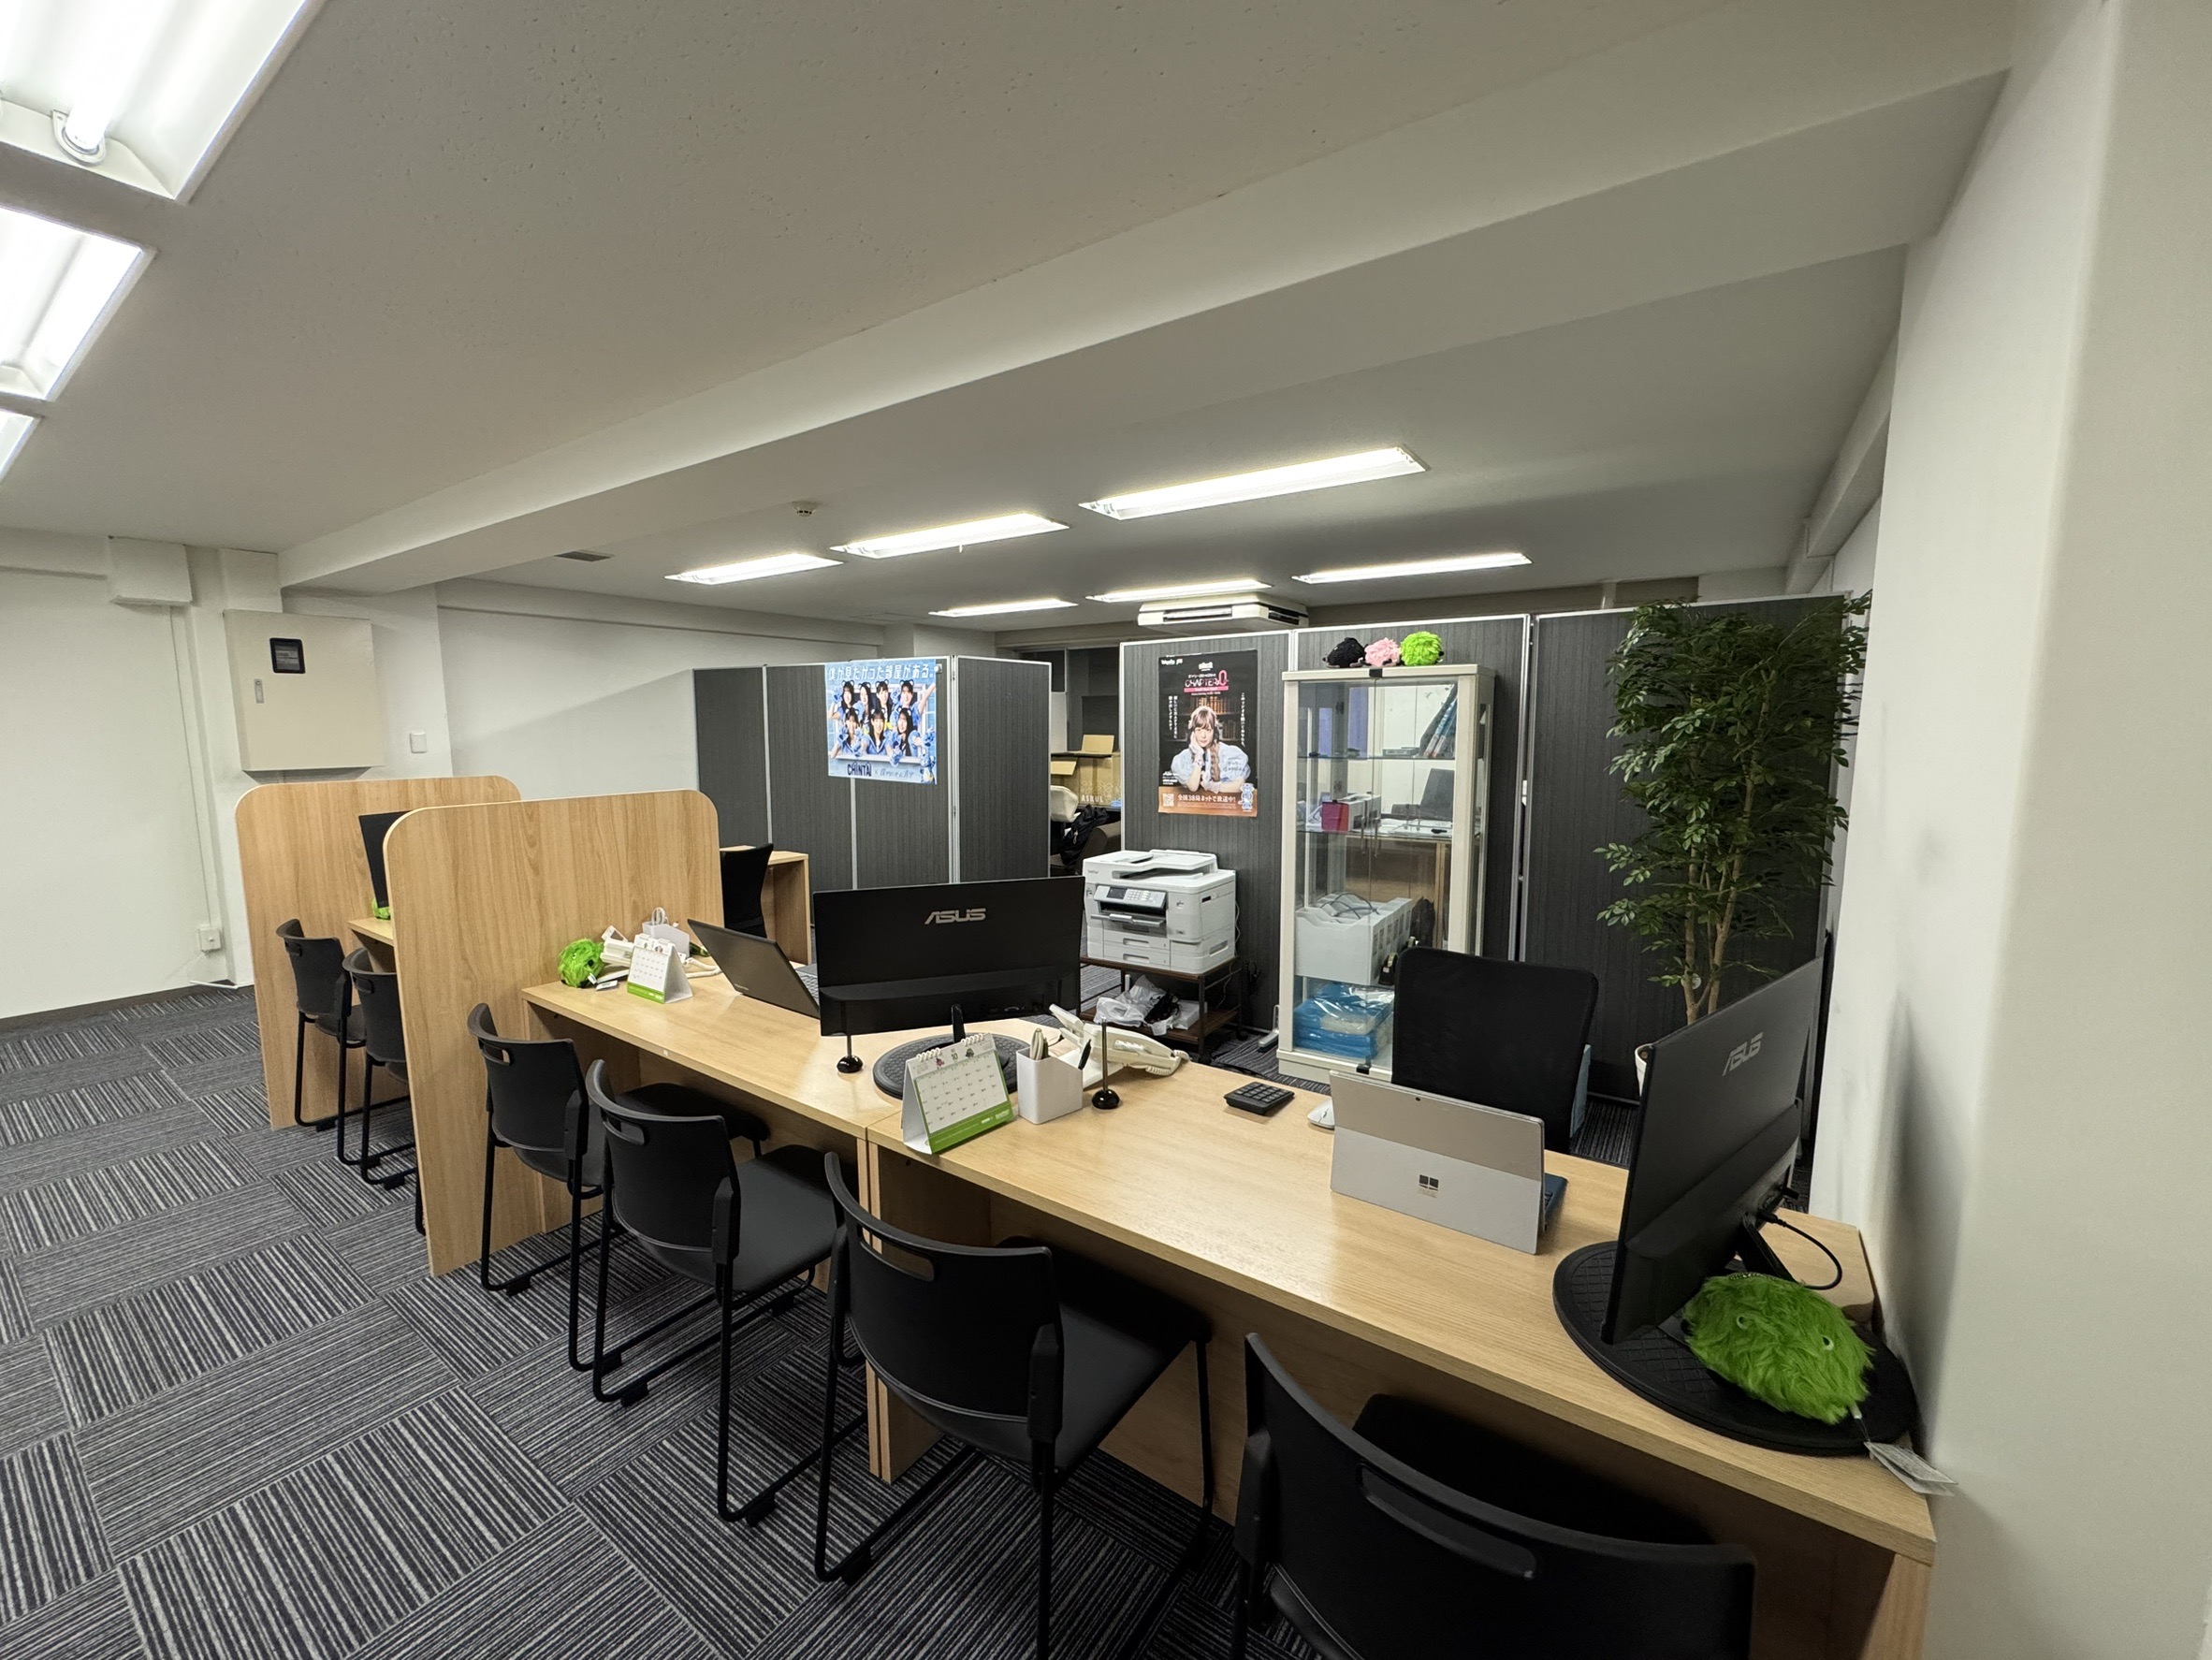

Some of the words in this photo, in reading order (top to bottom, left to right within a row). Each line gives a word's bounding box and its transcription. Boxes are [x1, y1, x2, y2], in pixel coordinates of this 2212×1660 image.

[829, 663, 933, 681] 僕が見たかった部屋がある。
[847, 761, 872, 777] CHINTAI
[1081, 794, 1103, 803] ASKUL
[924, 908, 986, 925] ASUS
[1722, 1031, 1764, 1077] ASUS
